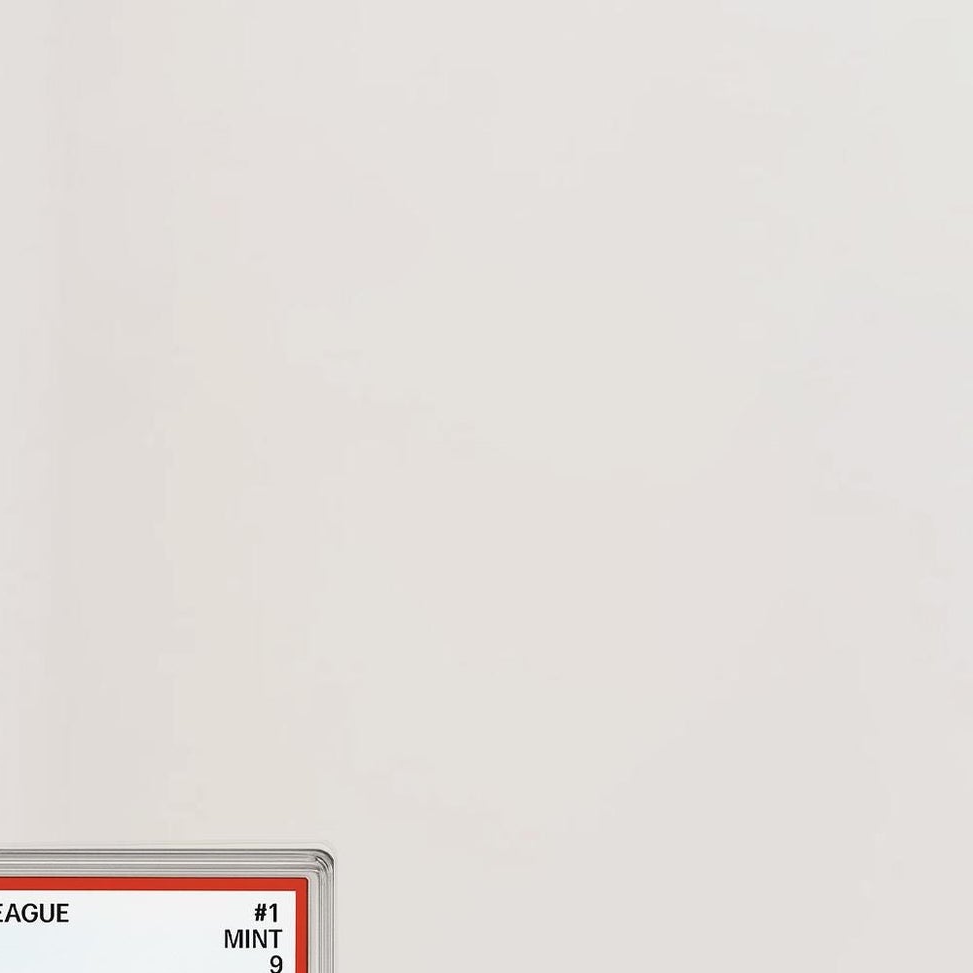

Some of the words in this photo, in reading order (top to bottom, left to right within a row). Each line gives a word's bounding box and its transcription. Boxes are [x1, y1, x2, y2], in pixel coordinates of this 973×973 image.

[254, 903, 279, 923] #1
[225, 930, 282, 948] MINT
[270, 955, 282, 973] 9
